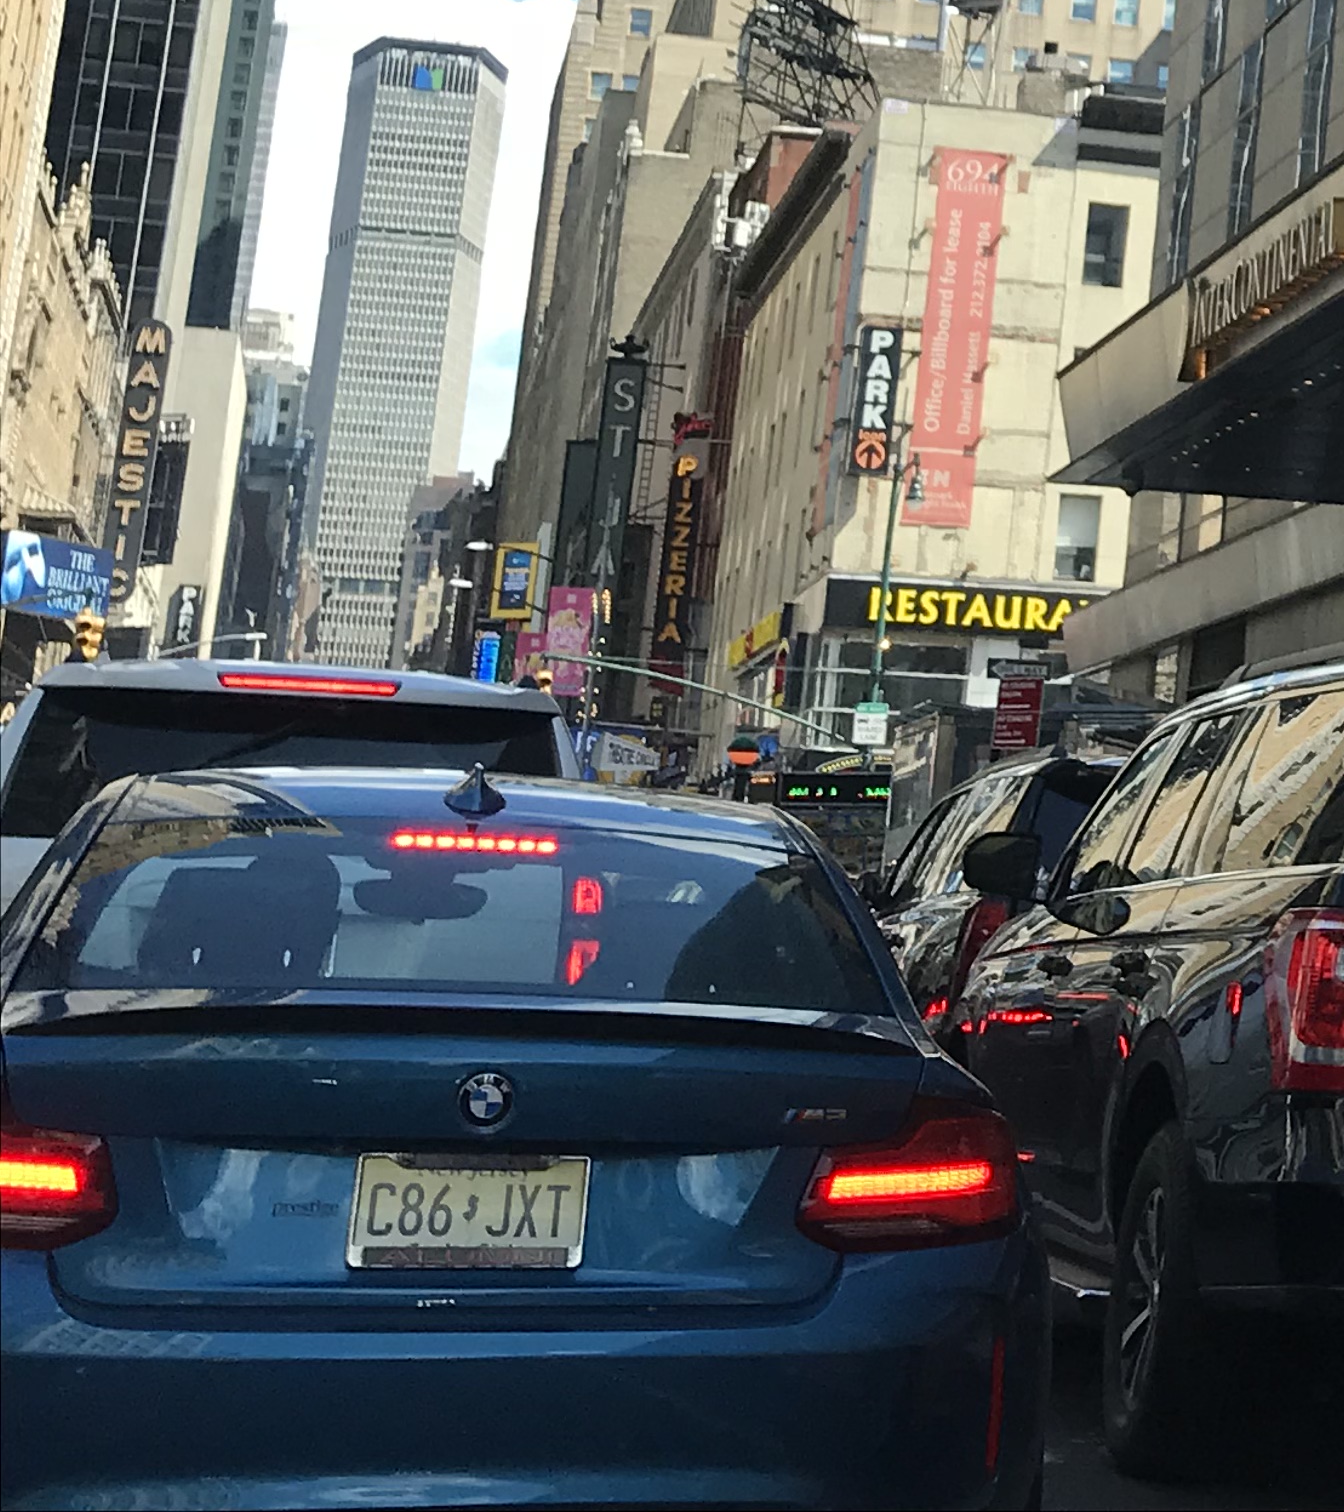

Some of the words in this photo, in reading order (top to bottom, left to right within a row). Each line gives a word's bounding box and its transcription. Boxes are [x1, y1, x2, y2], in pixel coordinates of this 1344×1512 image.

[943, 208, 963, 253] lease
[939, 257, 957, 285] for
[862, 329, 895, 430] PARK
[923, 287, 955, 433] Office/Billboard
[955, 387, 974, 435] Daniel
[69, 549, 96, 573] THE
[658, 454, 699, 645] PIZZERIA
[47, 566, 110, 597] BRILLIANT
[867, 585, 1089, 633] RESTAURA
[366, 1181, 454, 1237] C86
[484, 1183, 572, 1239] JXT
